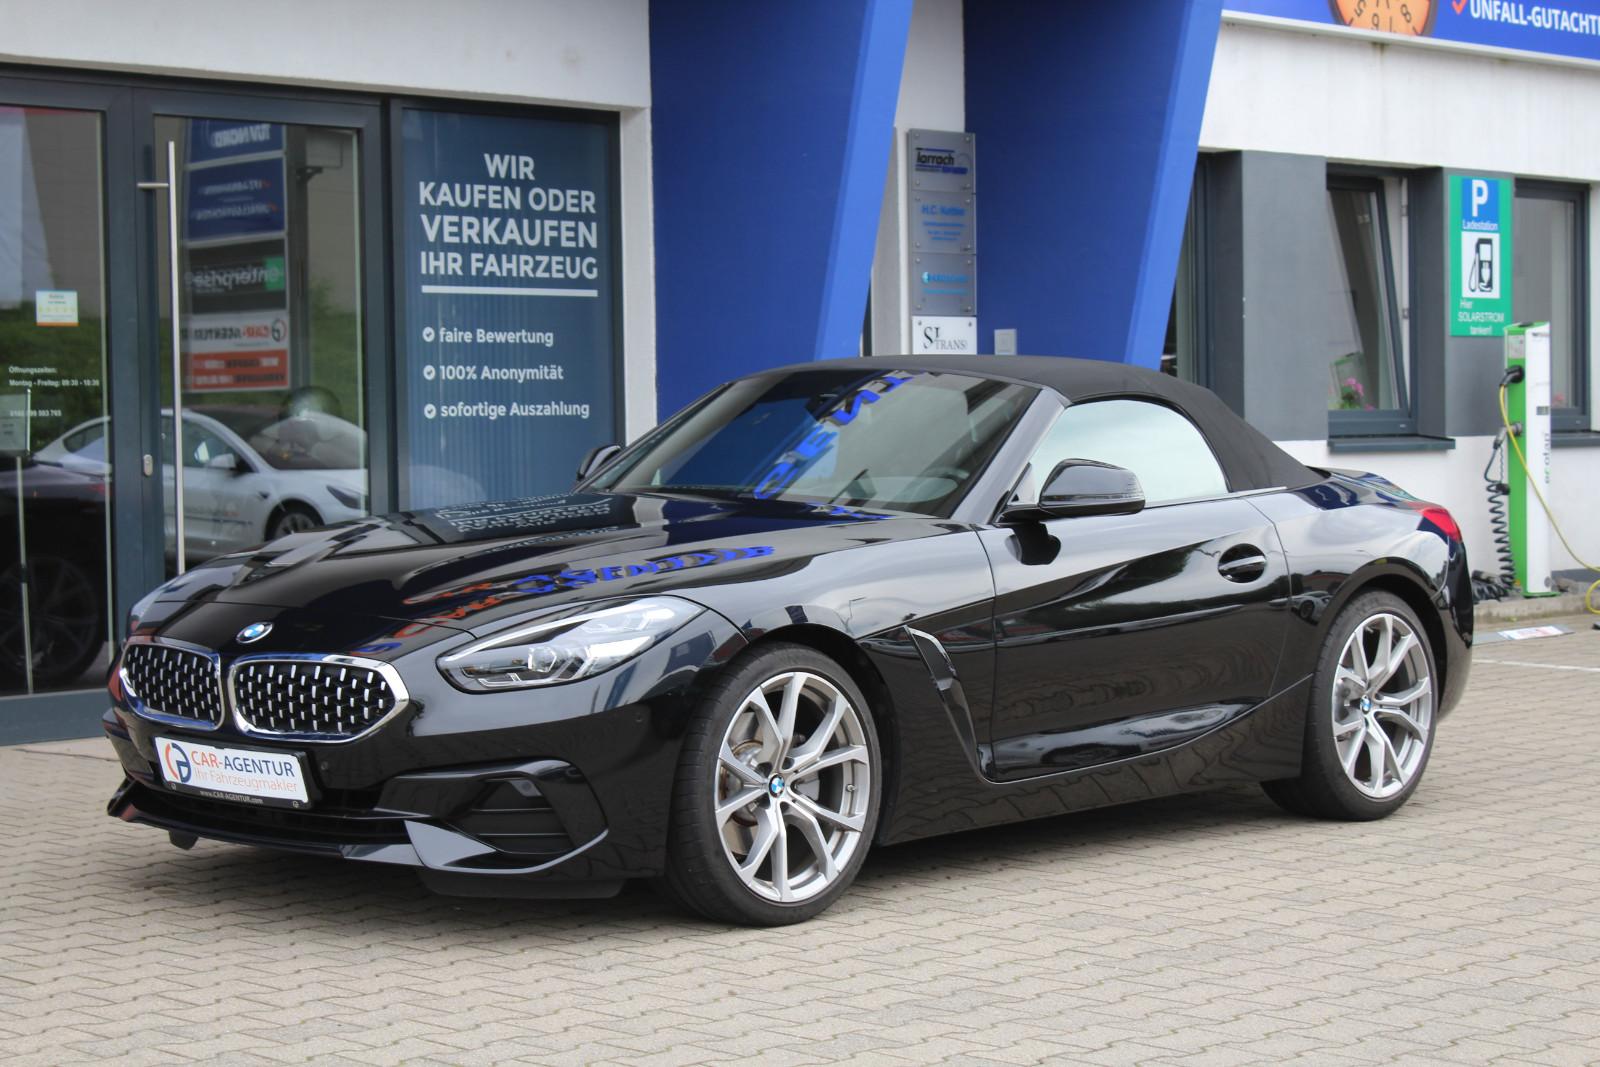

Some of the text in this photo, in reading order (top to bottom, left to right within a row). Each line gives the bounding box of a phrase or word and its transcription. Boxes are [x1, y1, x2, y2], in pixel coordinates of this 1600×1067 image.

[484, 153, 535, 180] WIR
[419, 181, 596, 213] KAUFEN ODER
[1472, 179, 1488, 217] P
[420, 214, 597, 248] VERKAUFEN
[1462, 219, 1498, 231] Ladestation
[421, 251, 598, 279] IHR FAHRZEUG
[1458, 311, 1504, 322] SOLARSTROM
[439, 327, 554, 347] faire Bewertung
[9, 379, 32, 388] Montag
[440, 365, 564, 383] 100% Anonymität
[441, 401, 590, 419] sofortige Auszahlung
[191, 750, 296, 778] CAR-AGENTUR
[195, 769, 298, 793] Ihr Fahrzeugmakler
